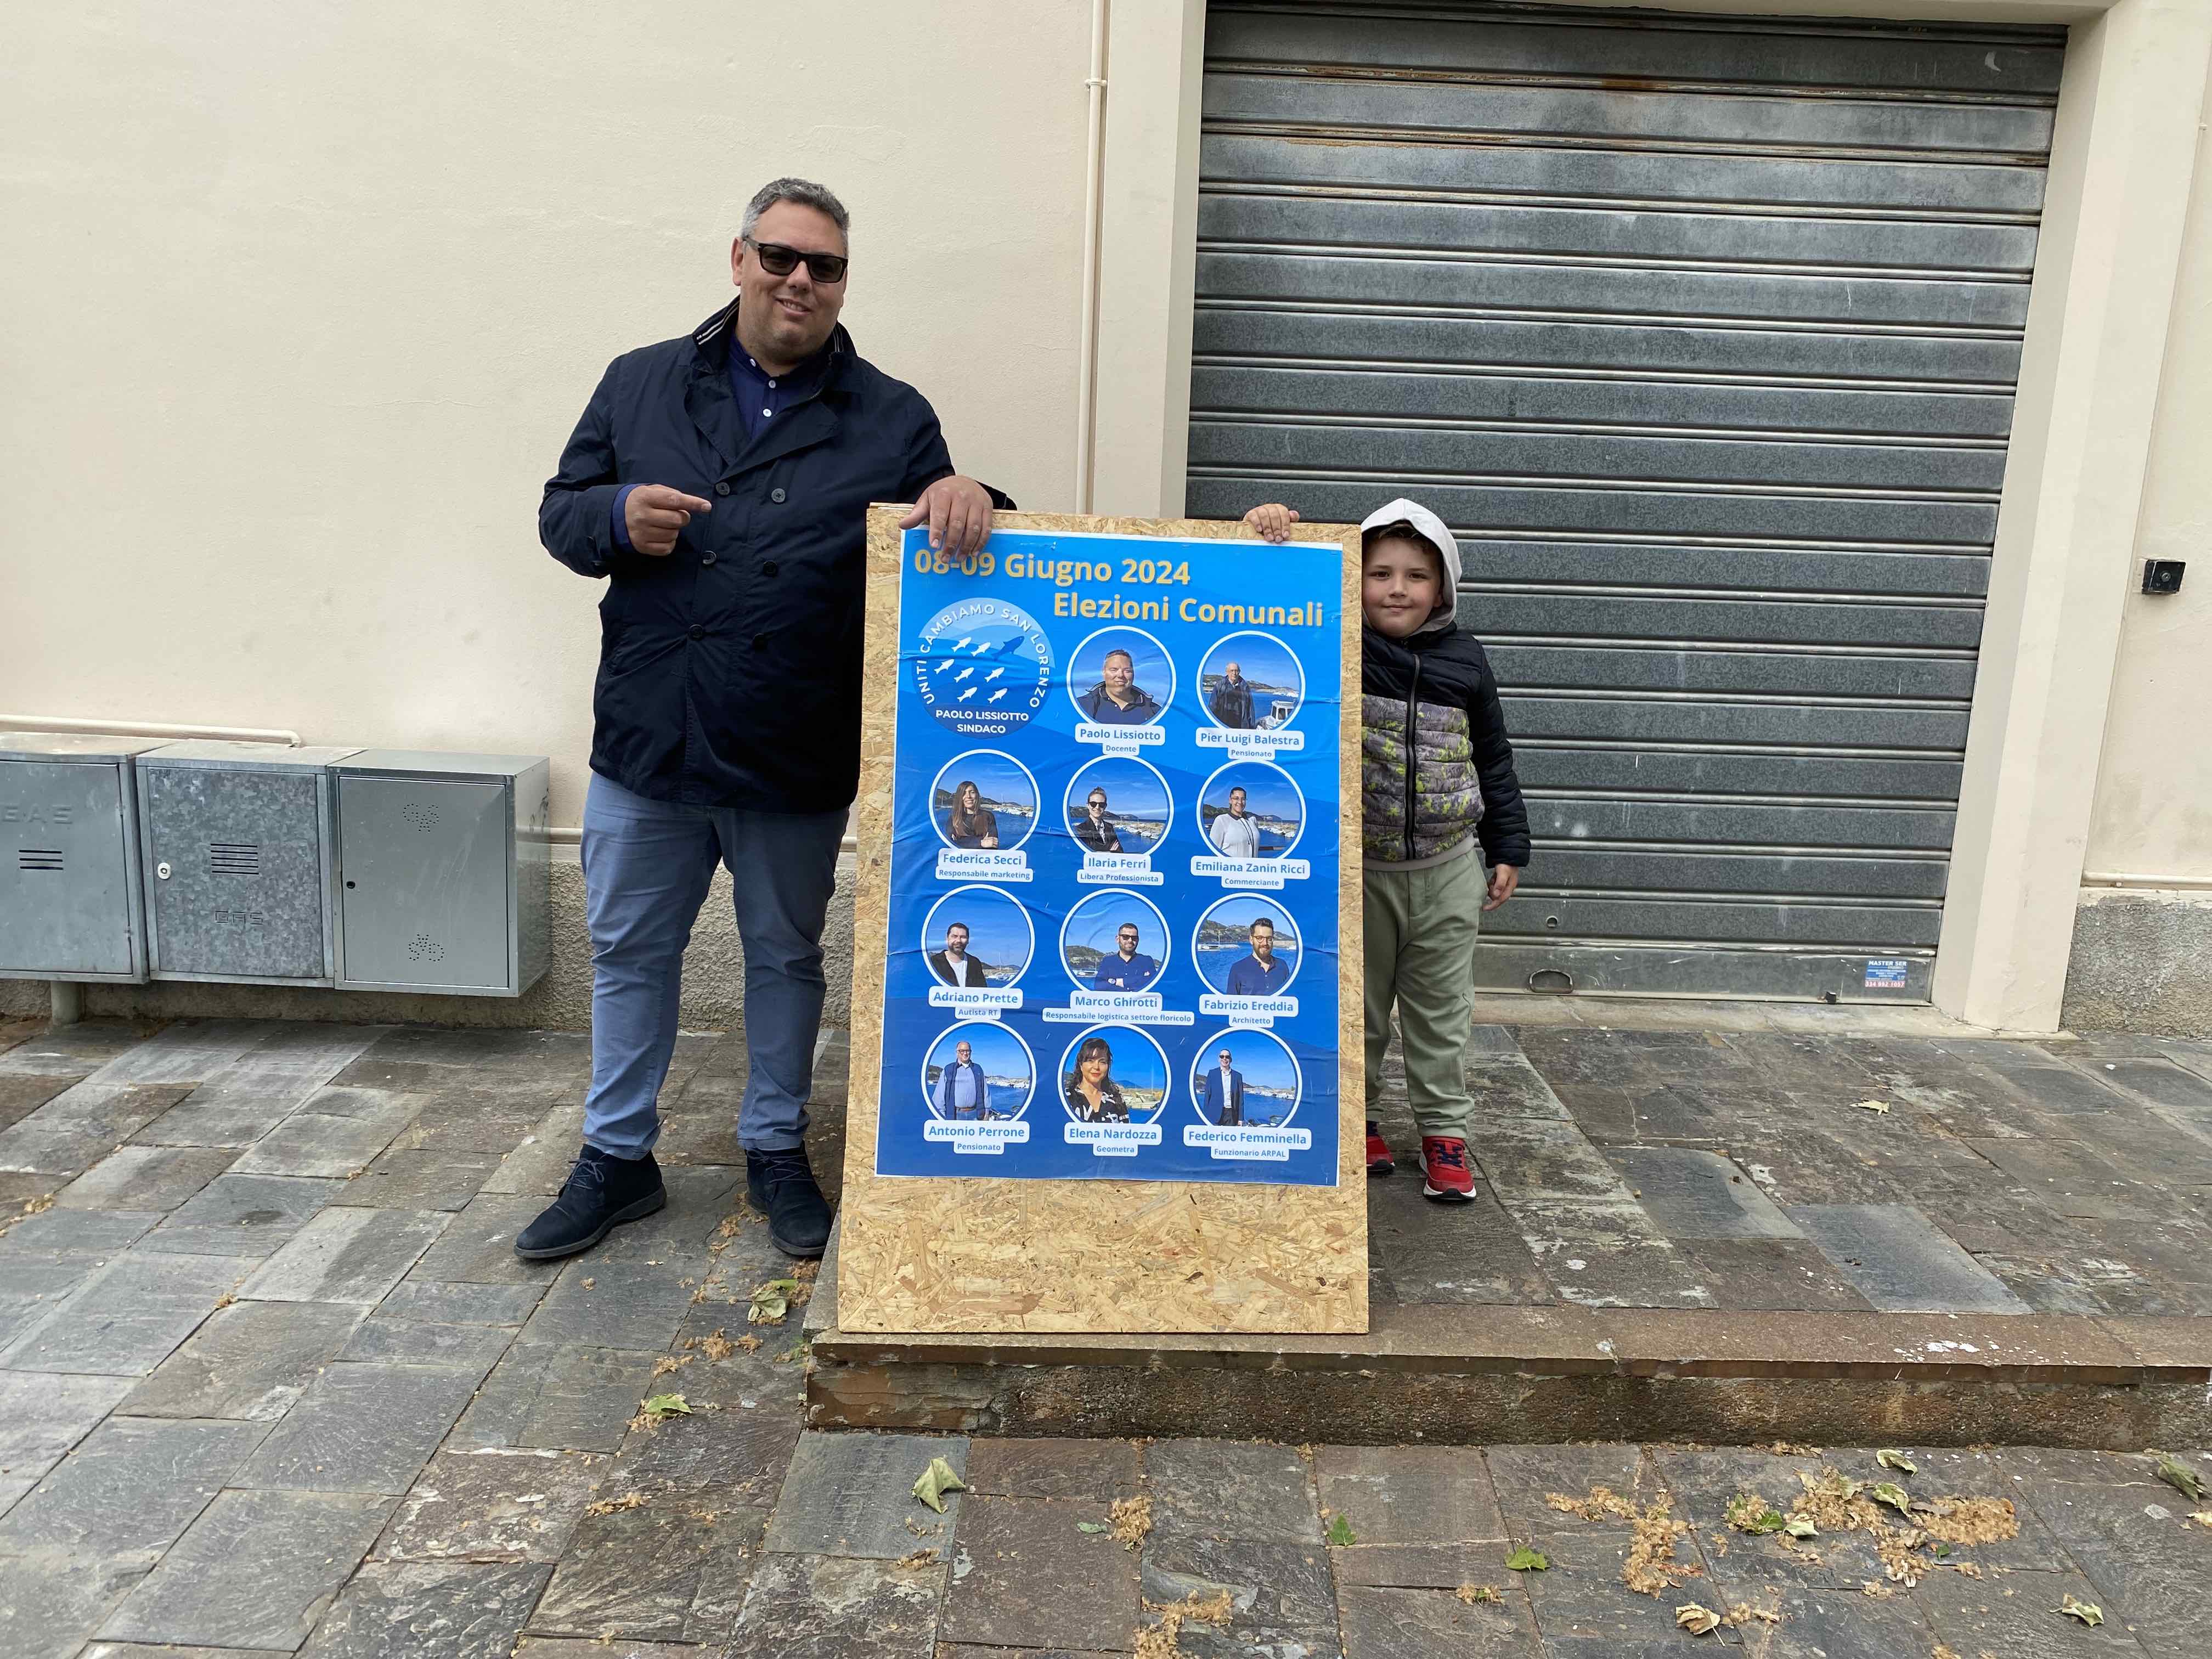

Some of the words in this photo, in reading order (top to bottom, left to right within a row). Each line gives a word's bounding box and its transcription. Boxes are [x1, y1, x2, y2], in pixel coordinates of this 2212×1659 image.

[915, 549, 996, 577] 08-09
[1005, 554, 1112, 587] Giugno
[1121, 558, 1190, 585] 2024
[1054, 592, 1169, 621] Elezioni
[1179, 598, 1323, 627] Comunali
[1001, 608, 1031, 633] SAN
[920, 604, 995, 653] CAMBIAMO
[1030, 634, 1049, 708] LORENZO
[916, 660, 935, 705] UNITI
[935, 710, 973, 720] PAOLO
[976, 712, 1029, 721] LISSIOTTO
[957, 724, 1006, 733] SINDACO
[1080, 728, 1110, 739] Paolo
[1114, 729, 1161, 741] Lissiotto
[1201, 732, 1223, 742] Pier
[1226, 733, 1251, 745] Luigi
[1255, 735, 1300, 746] Balestra
[1105, 744, 1137, 753] Docente
[1231, 749, 1272, 758] Pensionato
[943, 854, 990, 865] Federica
[994, 855, 1022, 865] Secci
[1088, 857, 1117, 868] Ilaria
[1120, 859, 1146, 868] Ferri
[1195, 861, 1243, 872] Emiliana
[1246, 863, 1277, 873] Zanin
[1280, 864, 1305, 874] Ricci
[939, 869, 989, 879] Responsabile
[991, 871, 1030, 880] marketing
[1106, 874, 1159, 882] Professionista
[1224, 878, 1279, 887] Commerciante
[215, 910, 264, 925] GAS
[933, 992, 979, 1003] Adriano
[983, 994, 1018, 1003] Prette
[1075, 996, 1110, 1006] Marco
[1113, 996, 1158, 1007] Ghirotti
[1204, 1000, 1248, 1011] Fabrizio
[1251, 1001, 1293, 1012] Ereddia
[1046, 1012, 1096, 1020] Responsabile
[1098, 1013, 1128, 1022] logistica
[1160, 1014, 1192, 1023] floricolo
[1232, 1016, 1271, 1024] Architetto
[928, 1126, 975, 1136] Antonio
[979, 1127, 1025, 1137] Perrone
[1070, 1128, 1100, 1138] Elena
[1104, 1130, 1157, 1140] Nardozza
[1189, 1131, 1237, 1142] Federico
[1240, 1132, 1307, 1144] Femminella
[957, 1143, 1001, 1151] Pensionato
[1097, 1145, 1135, 1153] Geometra
[1214, 1148, 1259, 1157] Funzionario
[1261, 1149, 1286, 1158] ARPAL
